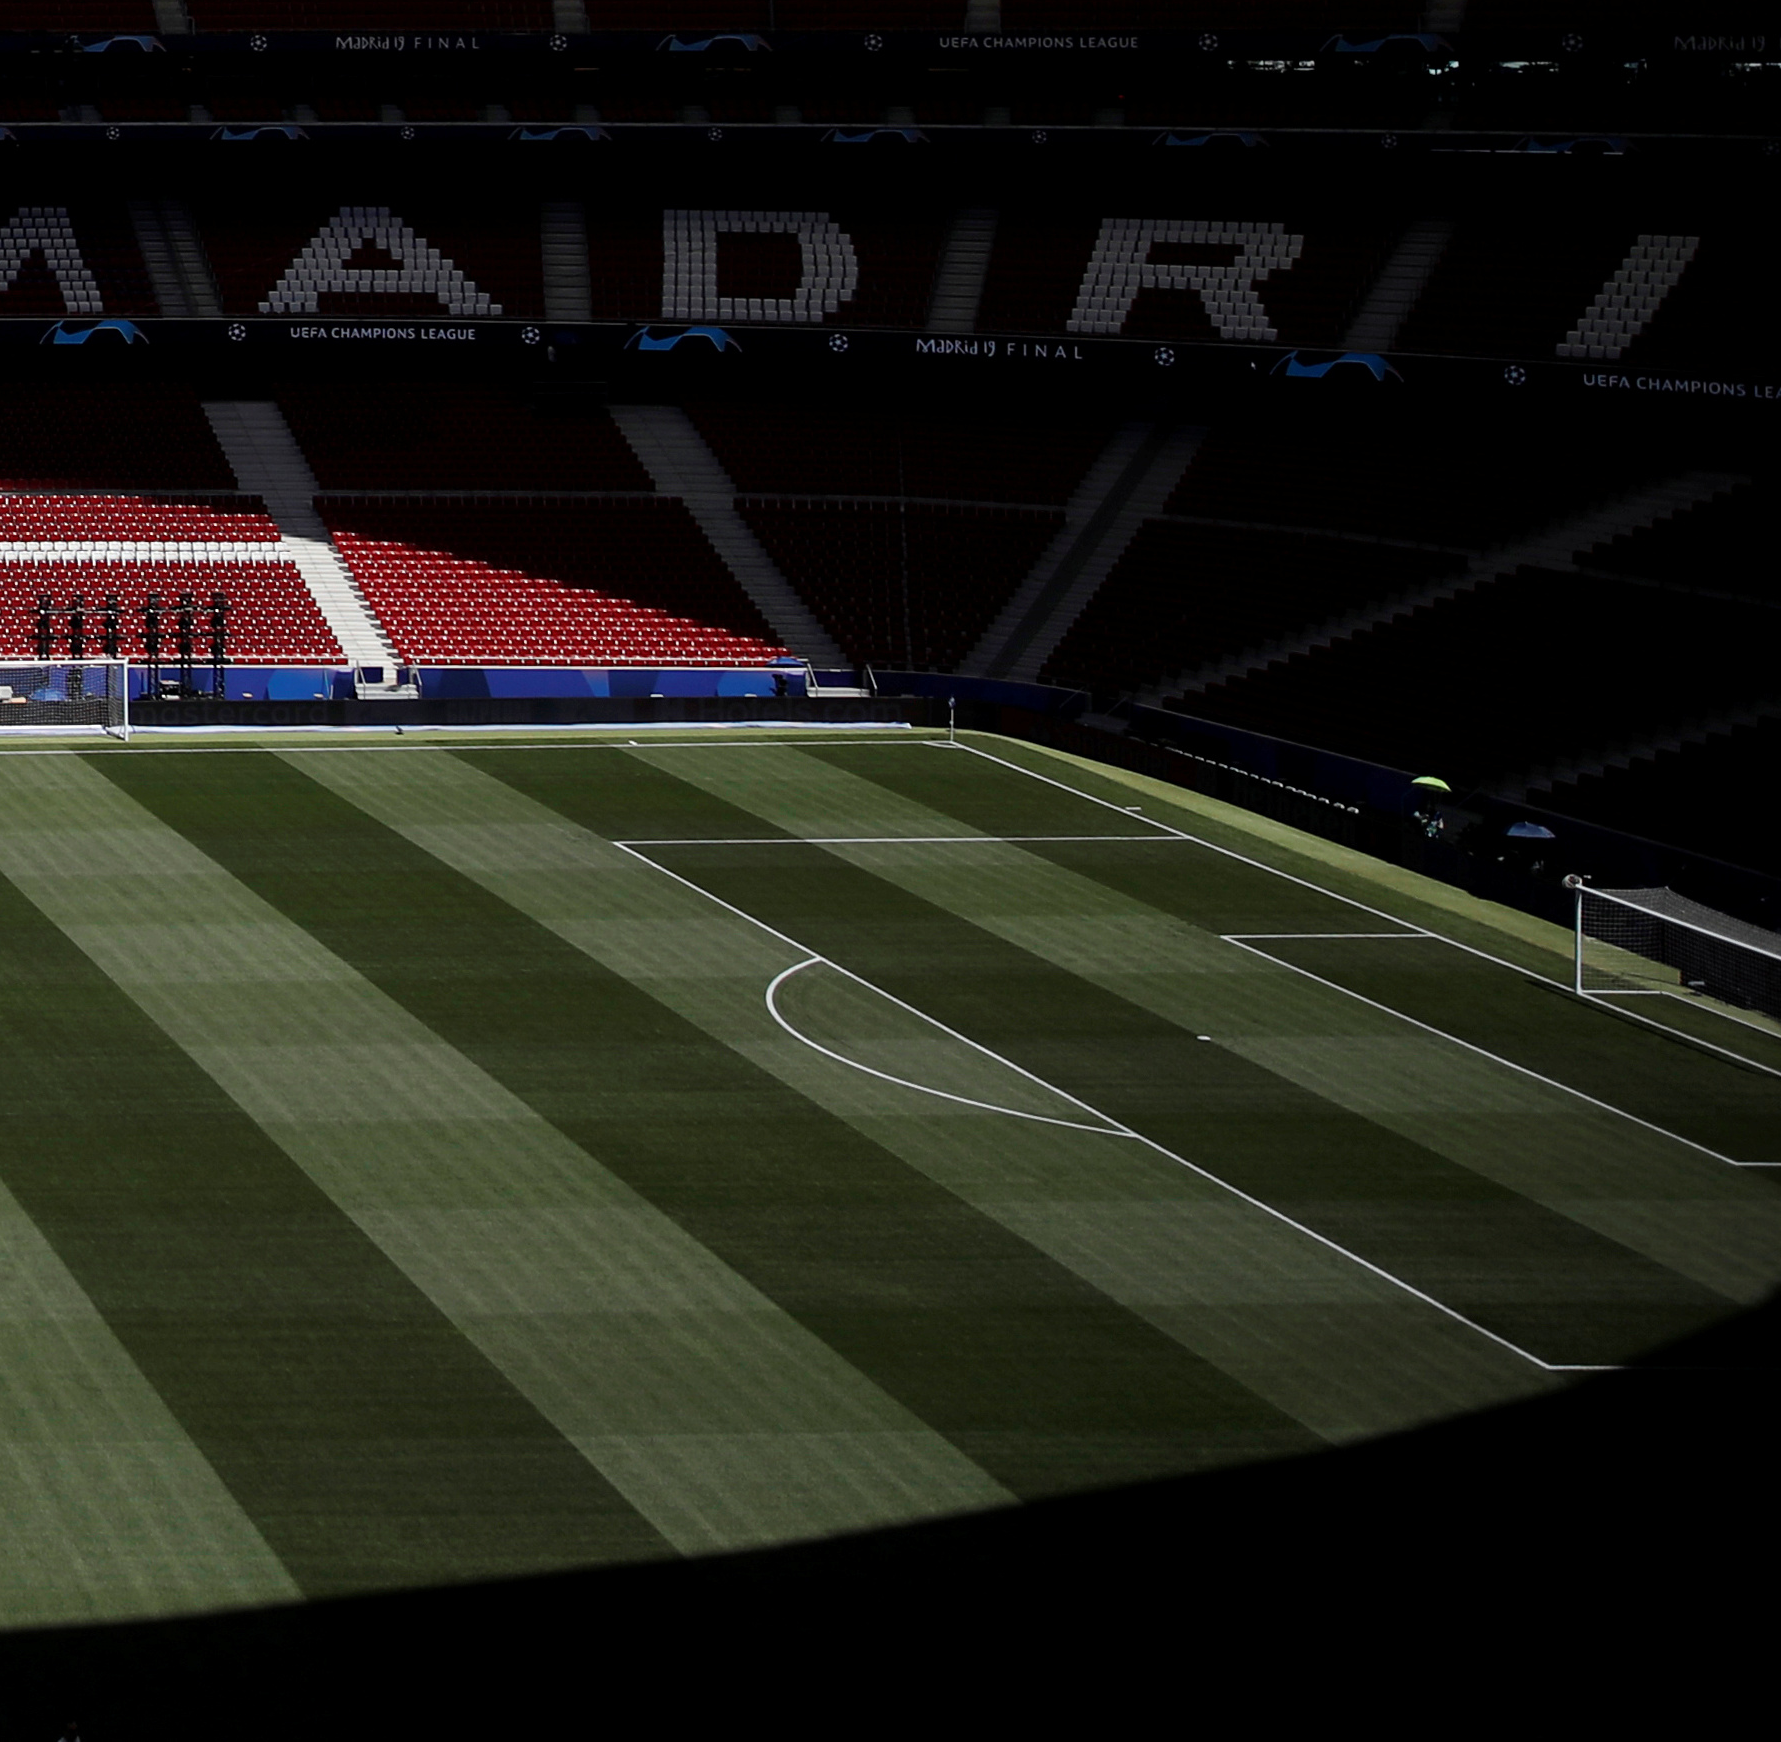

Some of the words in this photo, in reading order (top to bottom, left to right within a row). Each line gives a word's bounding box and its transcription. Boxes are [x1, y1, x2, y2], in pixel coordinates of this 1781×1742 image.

[394, 35, 405, 51] 19
[414, 36, 480, 50] FINAL
[939, 36, 979, 49] UEFA
[982, 36, 1074, 49] CHAMPIONS
[1079, 36, 1138, 49] LEAGUE
[1752, 35, 1766, 53] 19
[290, 326, 328, 339] UEFA
[331, 327, 416, 340] CHAMPIONS
[420, 328, 476, 340] LEAGUE
[983, 340, 996, 357] 19
[1007, 342, 1083, 360] FINAL
[1583, 373, 1631, 389] UEFA
[1636, 376, 1746, 397] CHAMPIONS
